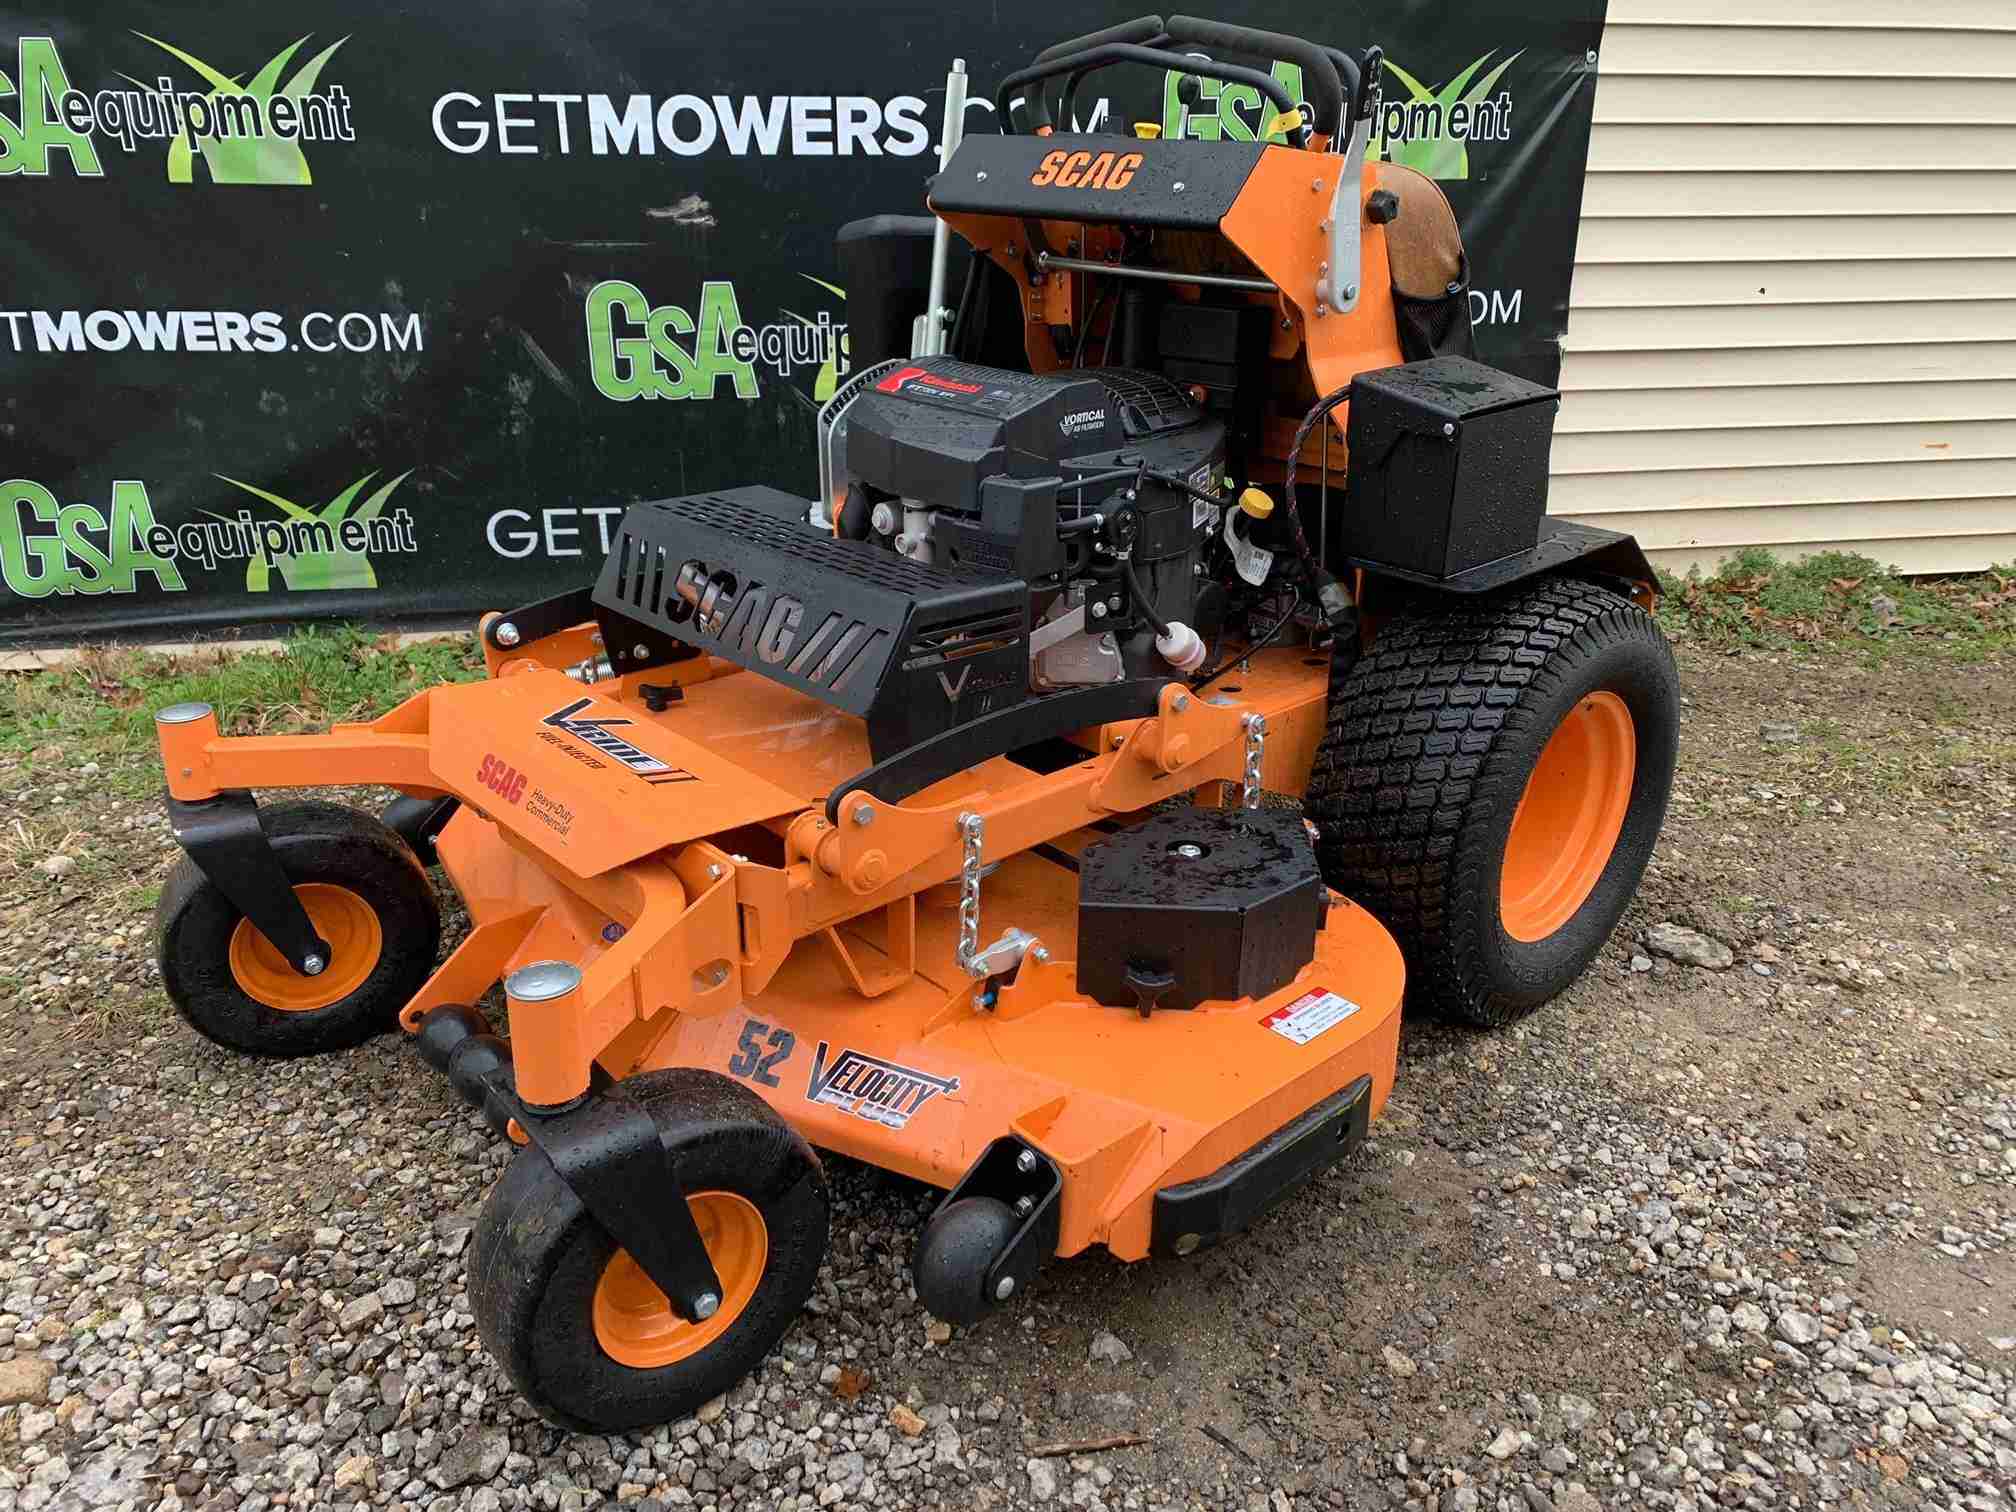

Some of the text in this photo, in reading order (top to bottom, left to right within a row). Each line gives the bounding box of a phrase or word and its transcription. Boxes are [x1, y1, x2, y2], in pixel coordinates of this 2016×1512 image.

[60, 77, 356, 152] equipment
[1031, 150, 1144, 190] SCAG
[1064, 409, 1105, 425] VORTICAL
[146, 509, 417, 568] equipment
[665, 559, 804, 664] SCAG
[476, 753, 528, 805] SCAG
[525, 801, 572, 837] Commercial
[530, 787, 576, 825] Heavy-Duty
[728, 1018, 797, 1089] 52
